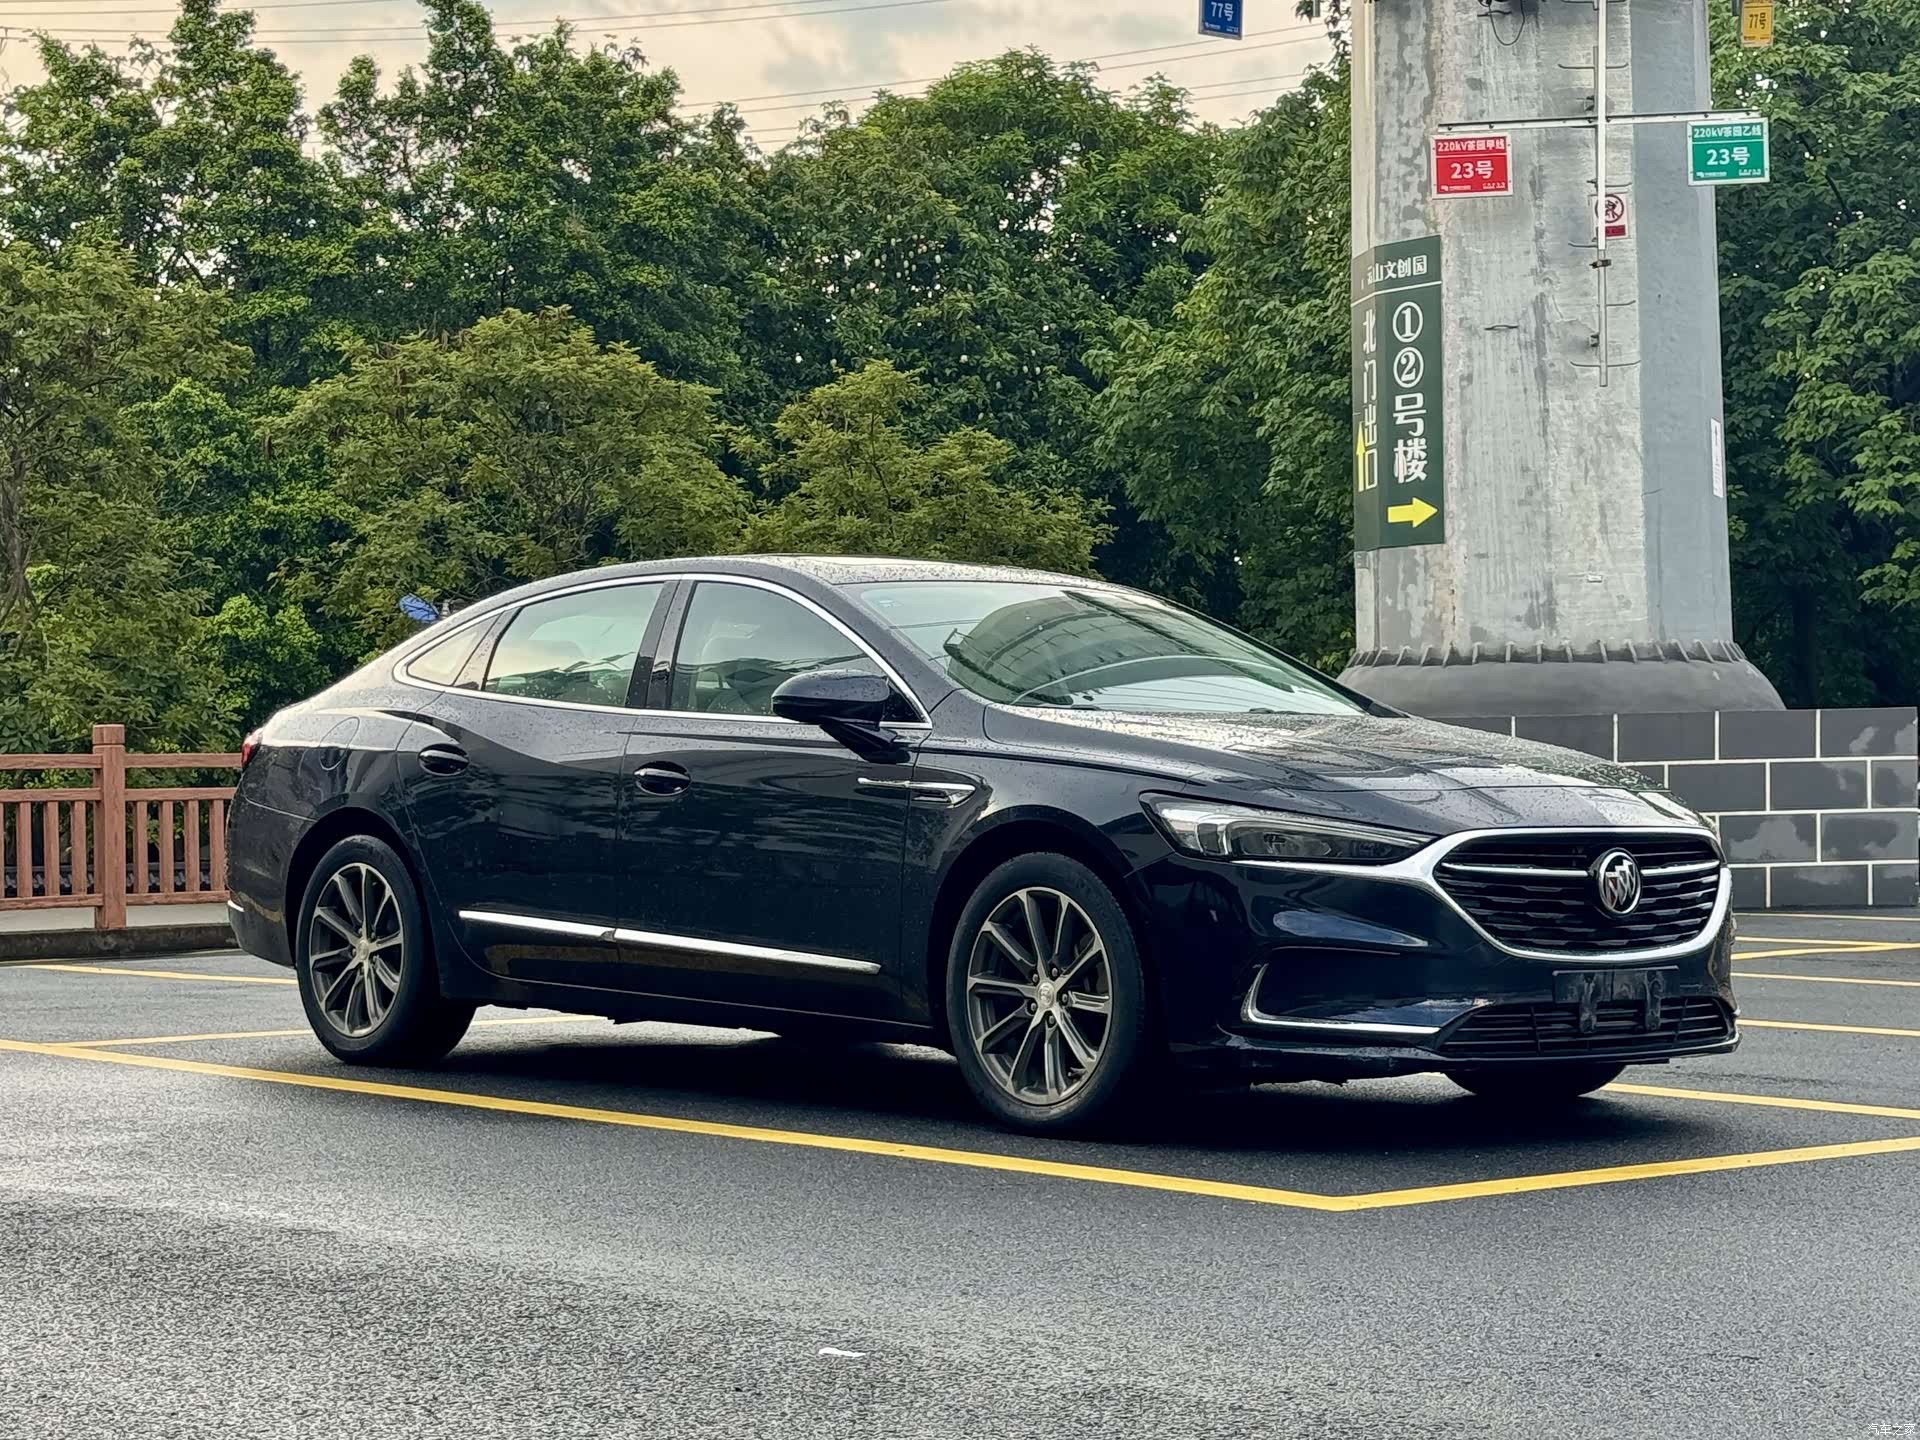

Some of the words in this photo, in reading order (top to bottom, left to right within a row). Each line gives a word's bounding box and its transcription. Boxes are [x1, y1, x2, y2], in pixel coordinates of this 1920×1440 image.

[1211, 1, 1234, 21] 77号
[1749, 12, 1766, 29] 77号
[1706, 146, 1750, 166] 23号
[1450, 160, 1494, 179] 23号
[1361, 255, 1427, 290] 云山文创园
[1363, 308, 1378, 490] 北门出口
